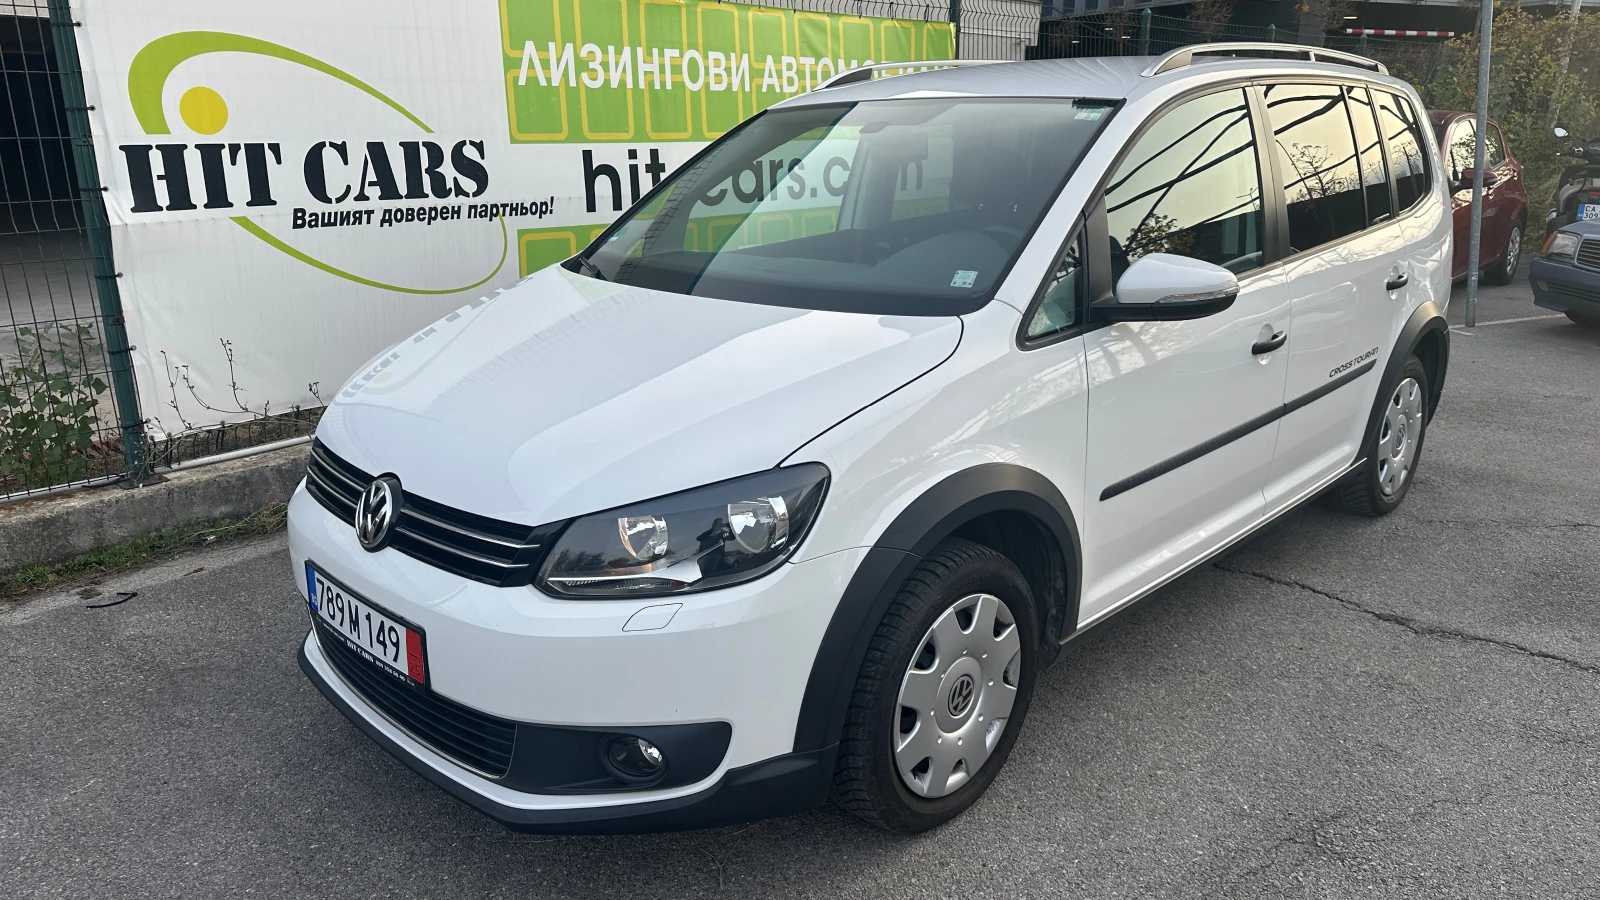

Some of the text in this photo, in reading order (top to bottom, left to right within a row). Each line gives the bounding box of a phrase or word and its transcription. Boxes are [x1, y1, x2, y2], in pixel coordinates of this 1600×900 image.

[518, 40, 752, 93] ЛИЗИНГОВИ
[118, 138, 489, 214] HIT CARS
[292, 196, 555, 229] Вашият доверен партньор!
[316, 577, 400, 663] 789 M 149
